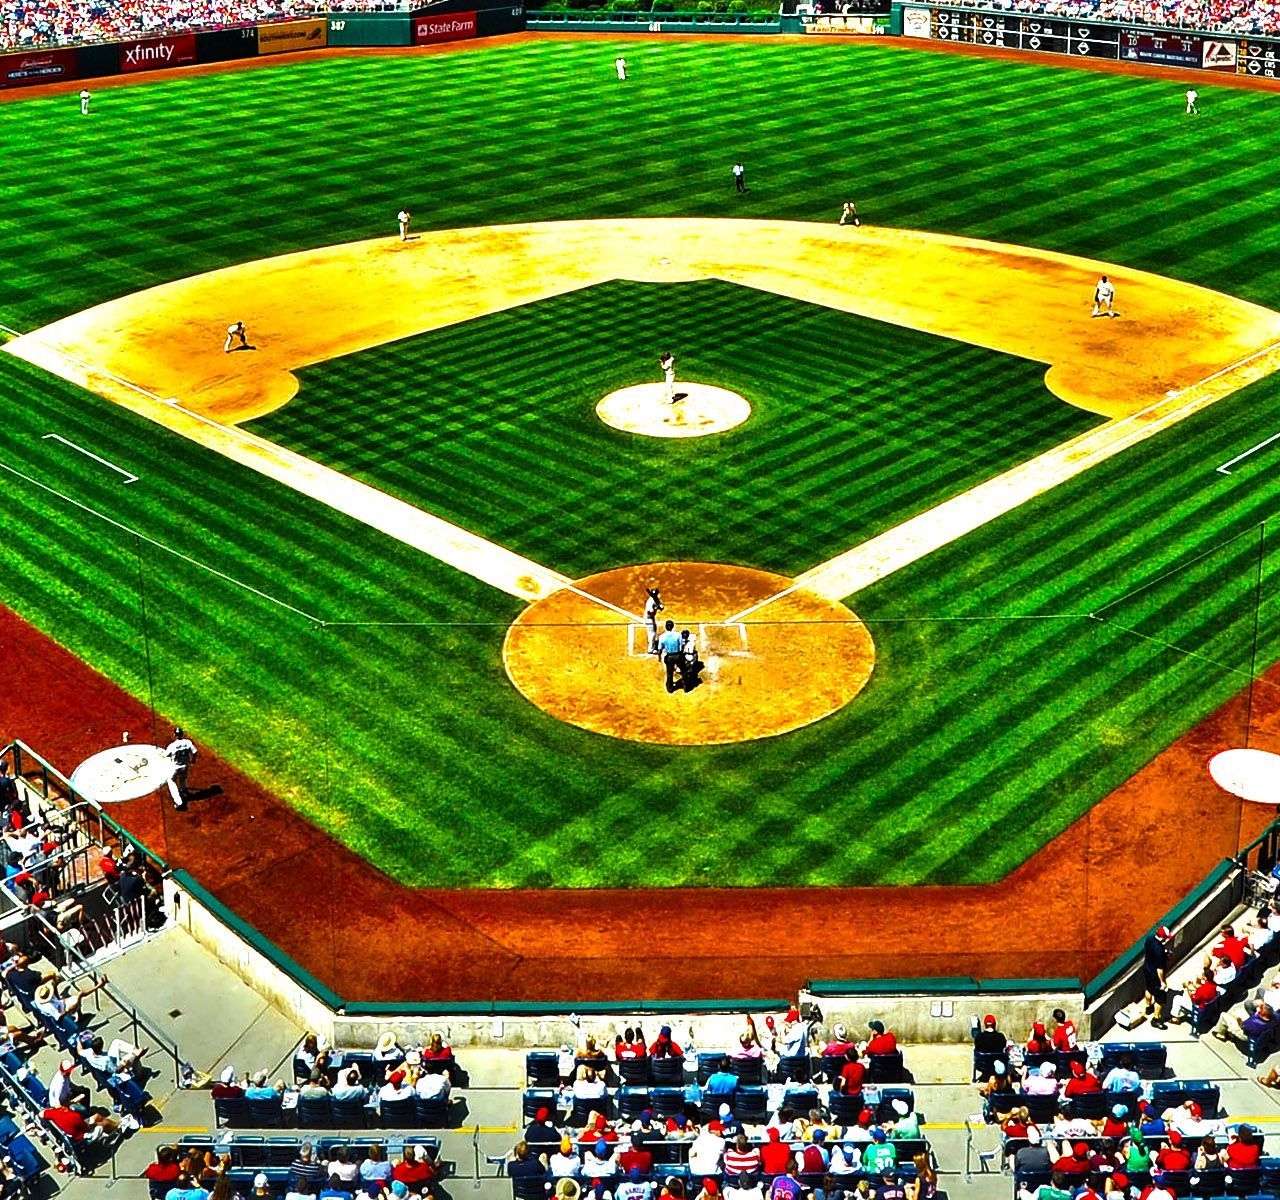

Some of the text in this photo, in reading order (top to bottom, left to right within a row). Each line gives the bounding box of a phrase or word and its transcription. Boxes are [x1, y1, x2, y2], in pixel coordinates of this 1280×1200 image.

[241, 29, 255, 38] 374
[429, 20, 473, 35] State Farm
[1128, 38, 1191, 52] 10 21 31
[125, 43, 175, 65] xfinity
